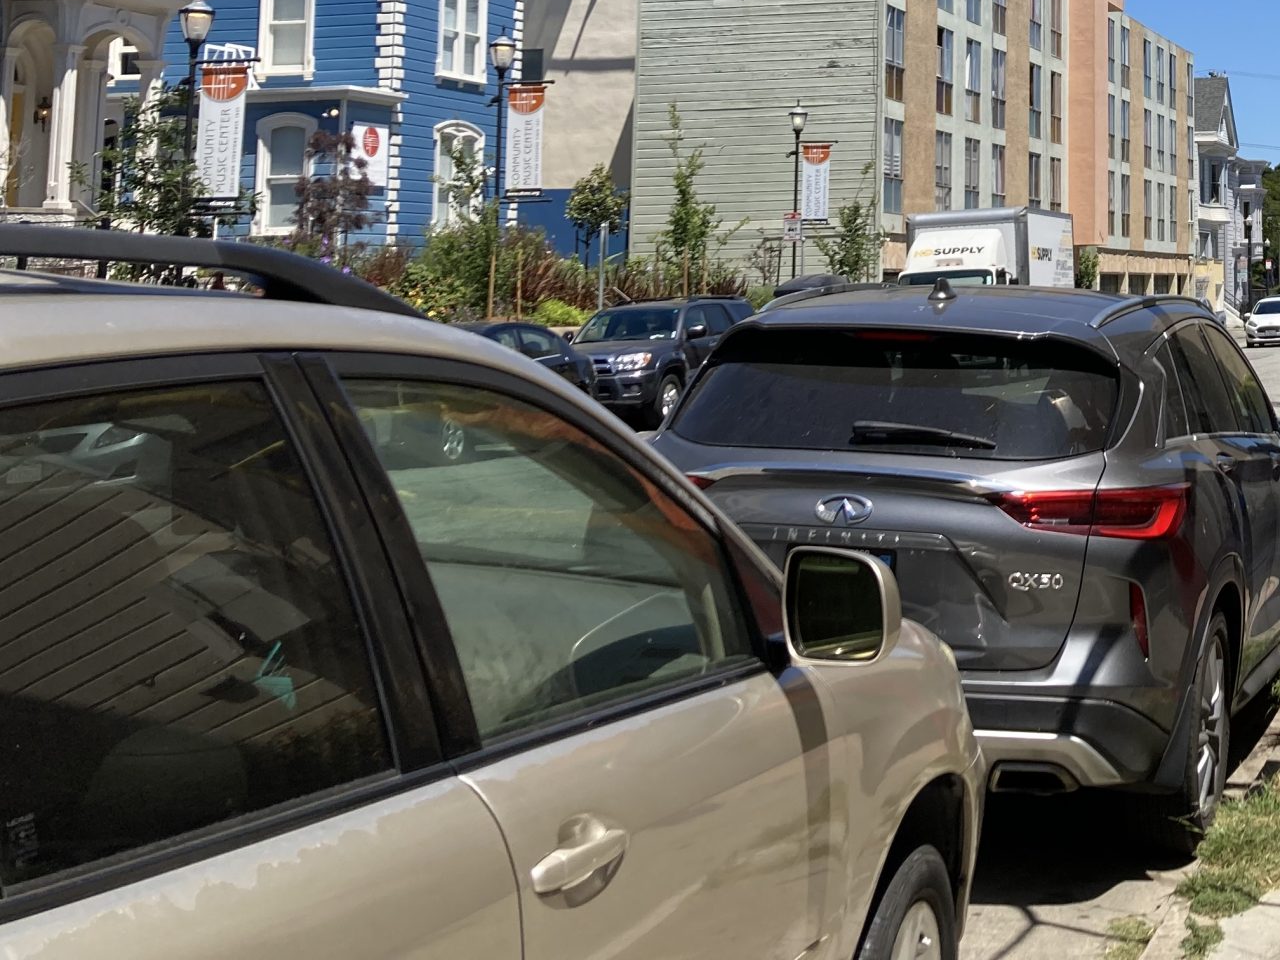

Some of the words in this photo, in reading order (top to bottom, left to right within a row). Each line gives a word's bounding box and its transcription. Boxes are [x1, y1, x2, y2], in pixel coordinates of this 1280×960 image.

[218, 108, 231, 153] CENTER
[524, 119, 533, 154] CENTER
[202, 119, 216, 191] OMMUNITY
[511, 128, 521, 186] COMMUNITY
[523, 158, 532, 186] MUSIC
[215, 156, 227, 193] MUSIC
[933, 246, 985, 256] SUPPLY
[771, 526, 900, 544] INFINITI
[1008, 571, 1065, 591] QX50
